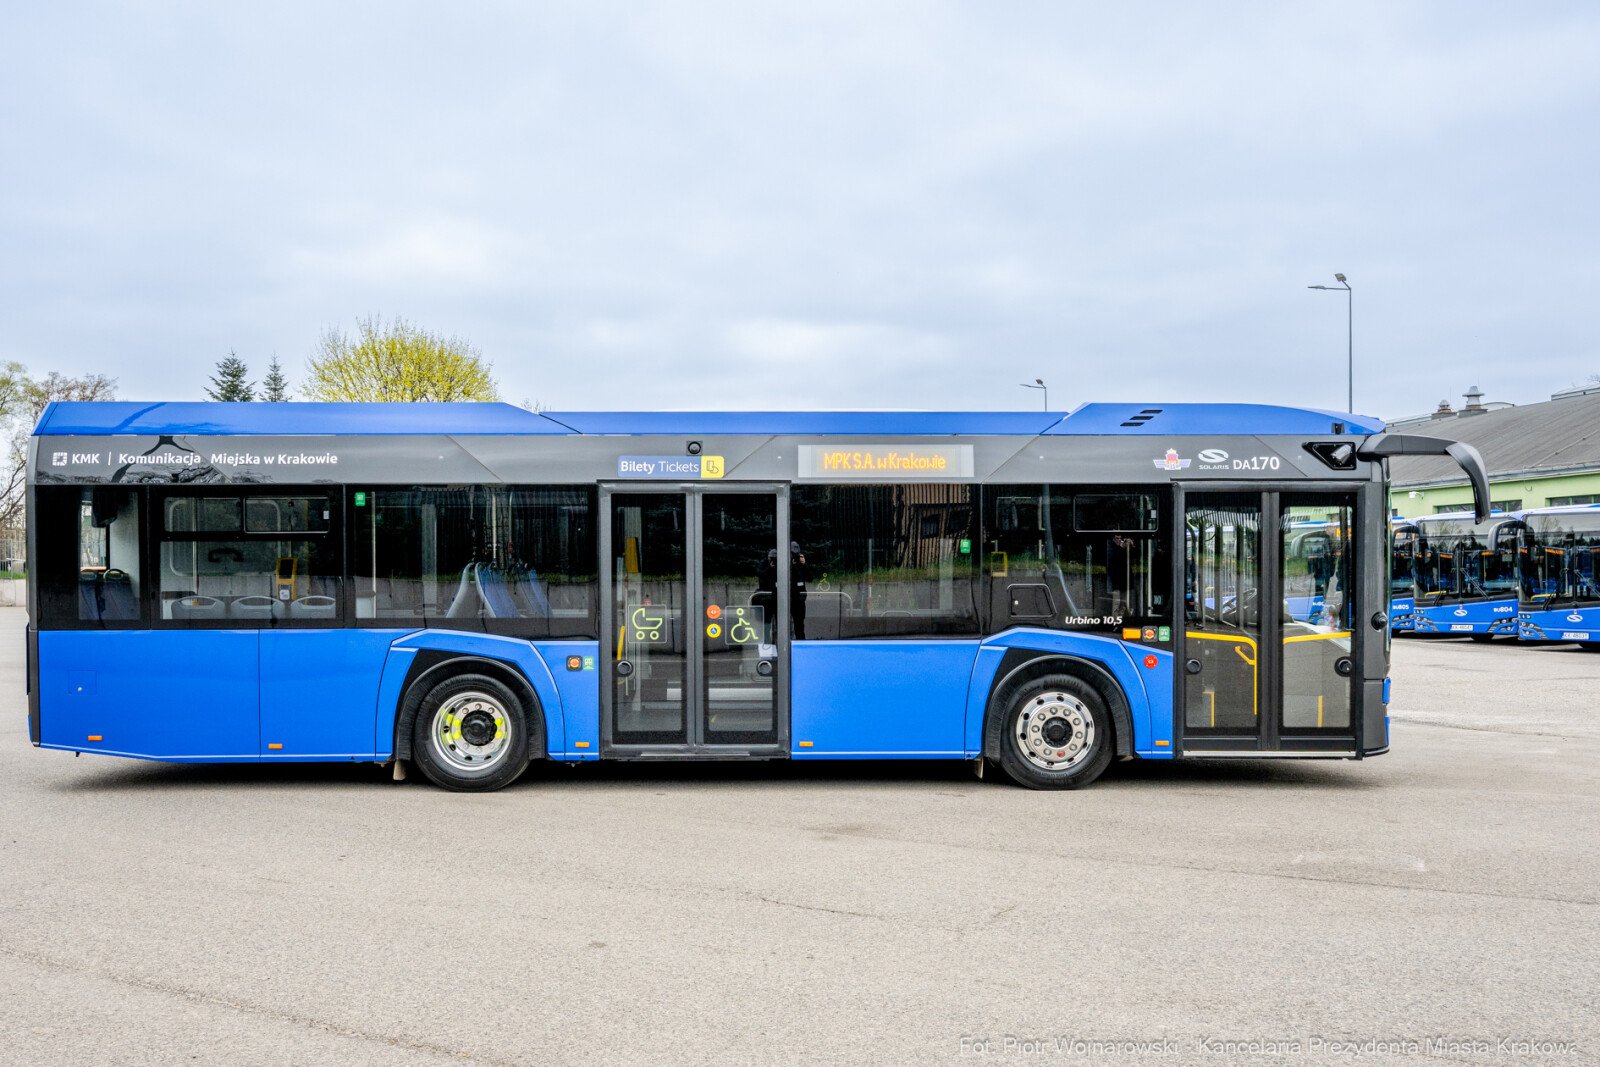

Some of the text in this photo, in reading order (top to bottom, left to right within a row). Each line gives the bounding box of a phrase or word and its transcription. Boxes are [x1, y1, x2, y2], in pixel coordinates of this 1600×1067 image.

[71, 452, 338, 467] KMK Komunikacja Miejska w Krakowie
[823, 452, 947, 470] MPK S.A. w Krakowie
[1233, 456, 1280, 470] DA170
[620, 460, 700, 475] Bilety Tickets
[1065, 615, 1123, 626] Urbino 10,5
